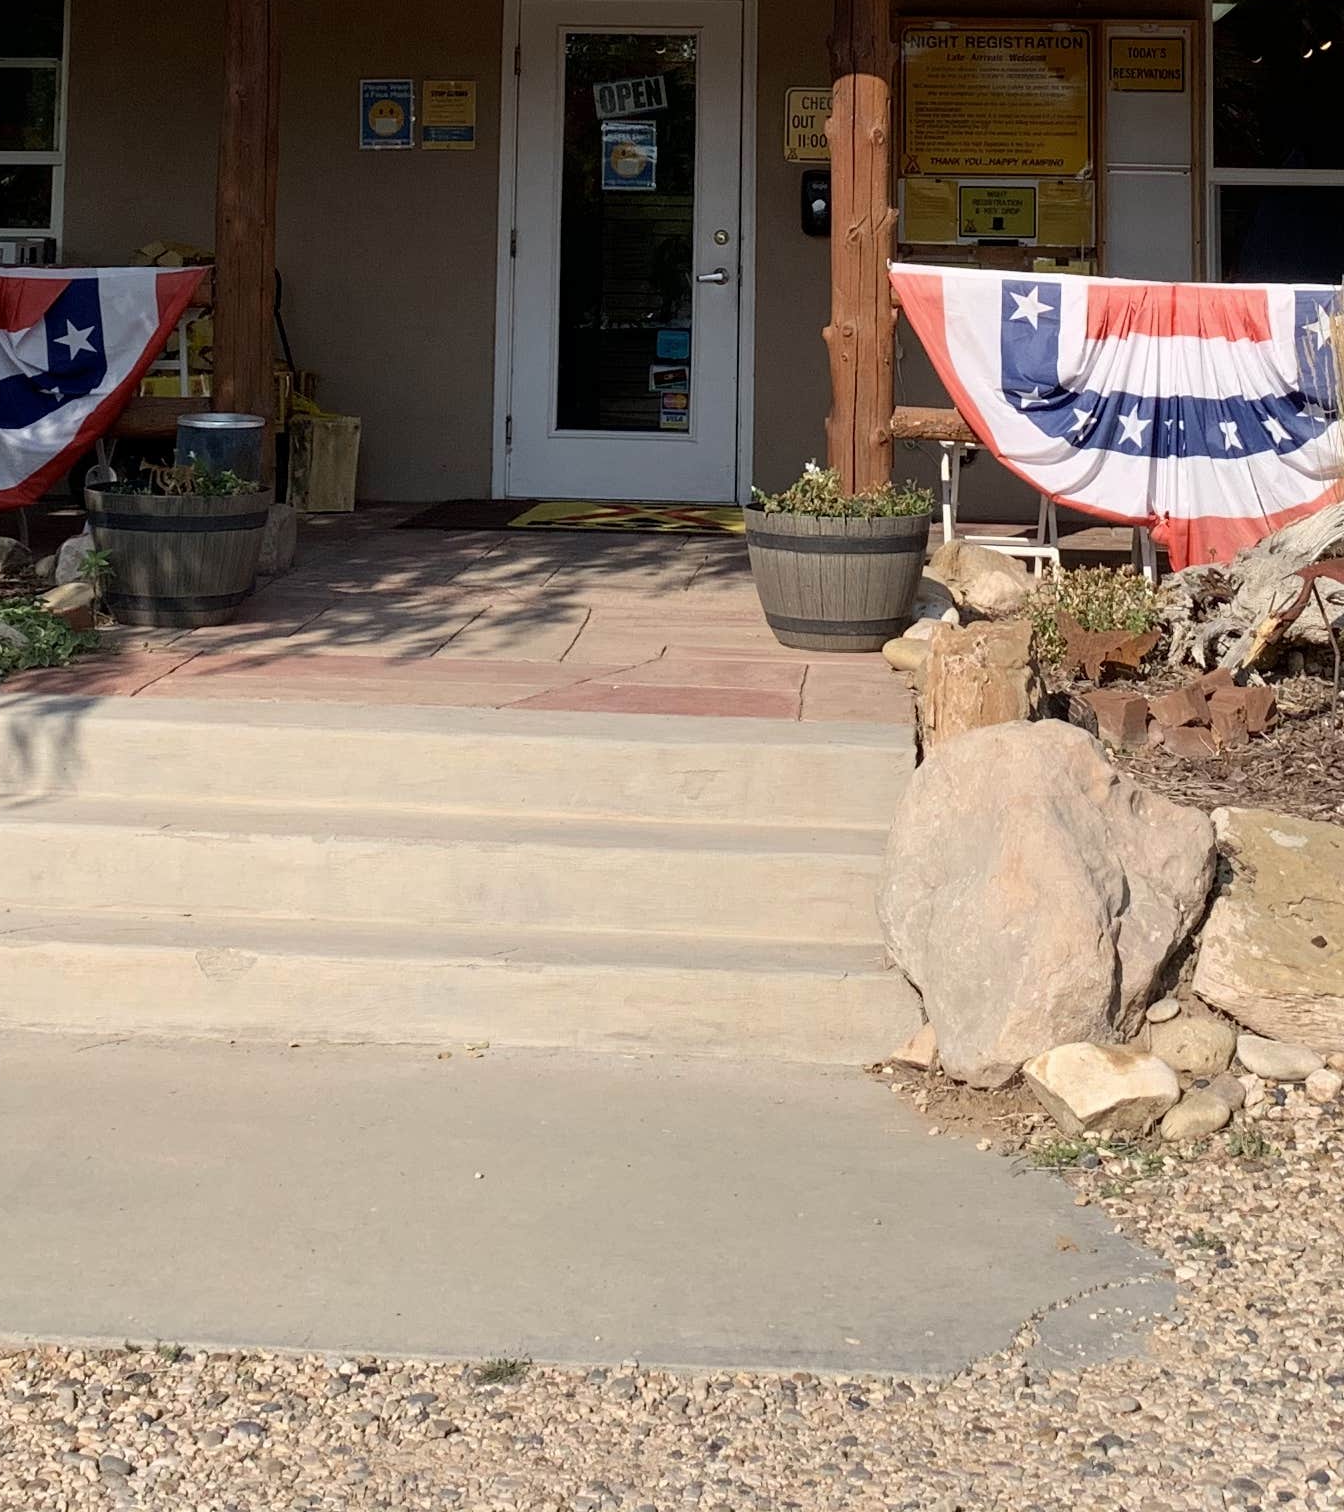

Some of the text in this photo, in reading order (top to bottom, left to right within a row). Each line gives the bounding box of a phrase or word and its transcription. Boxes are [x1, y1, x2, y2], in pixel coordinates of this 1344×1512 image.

[910, 35, 1084, 49] NIGHT REGISTRATION
[1128, 47, 1167, 58] TODAY'S
[1113, 67, 1181, 80] RESERVATIONS
[599, 78, 663, 113] OPEN
[801, 96, 834, 110] CHEC
[792, 115, 815, 129] OUT
[798, 134, 828, 148] 11:00
[930, 157, 960, 166] THANK
